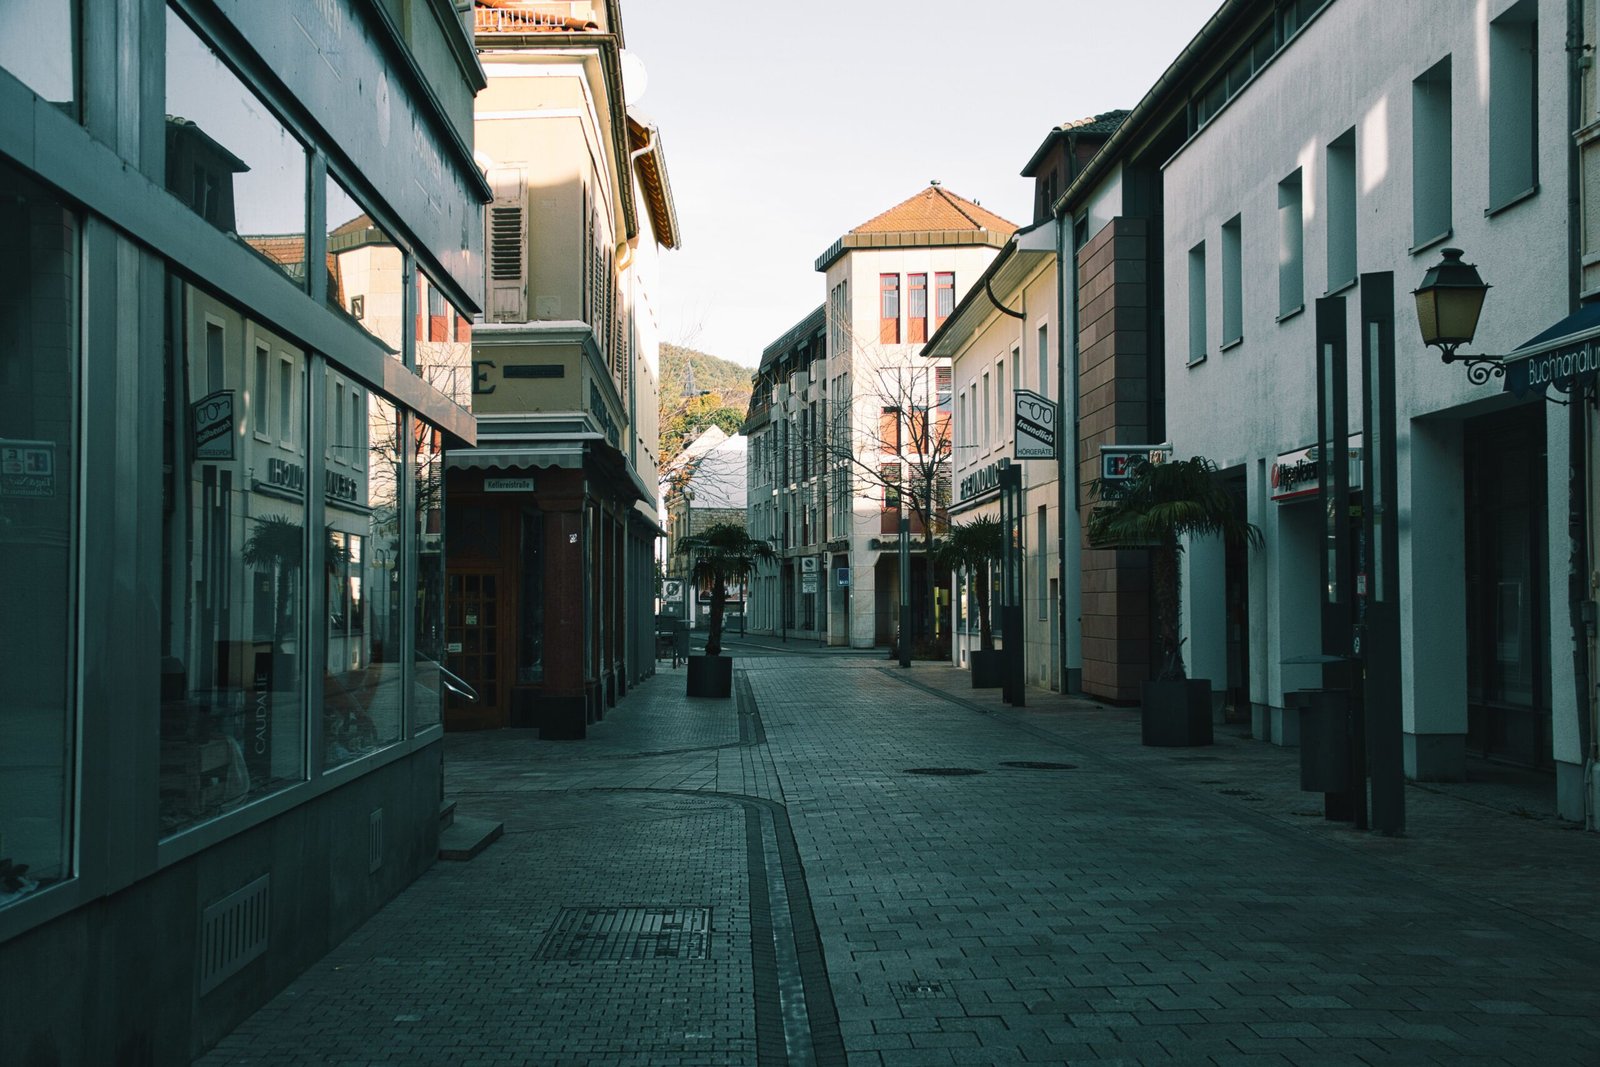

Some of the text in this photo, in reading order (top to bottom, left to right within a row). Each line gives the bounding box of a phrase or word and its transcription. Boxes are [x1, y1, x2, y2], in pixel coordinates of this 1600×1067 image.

[1528, 341, 1600, 386] Buchhandlu
[1016, 418, 1054, 443] freundlich
[1017, 447, 1053, 456] HÖRGERÄTE
[487, 480, 530, 489] Kellereistraße
[960, 457, 1010, 501] FREUNDLIC
